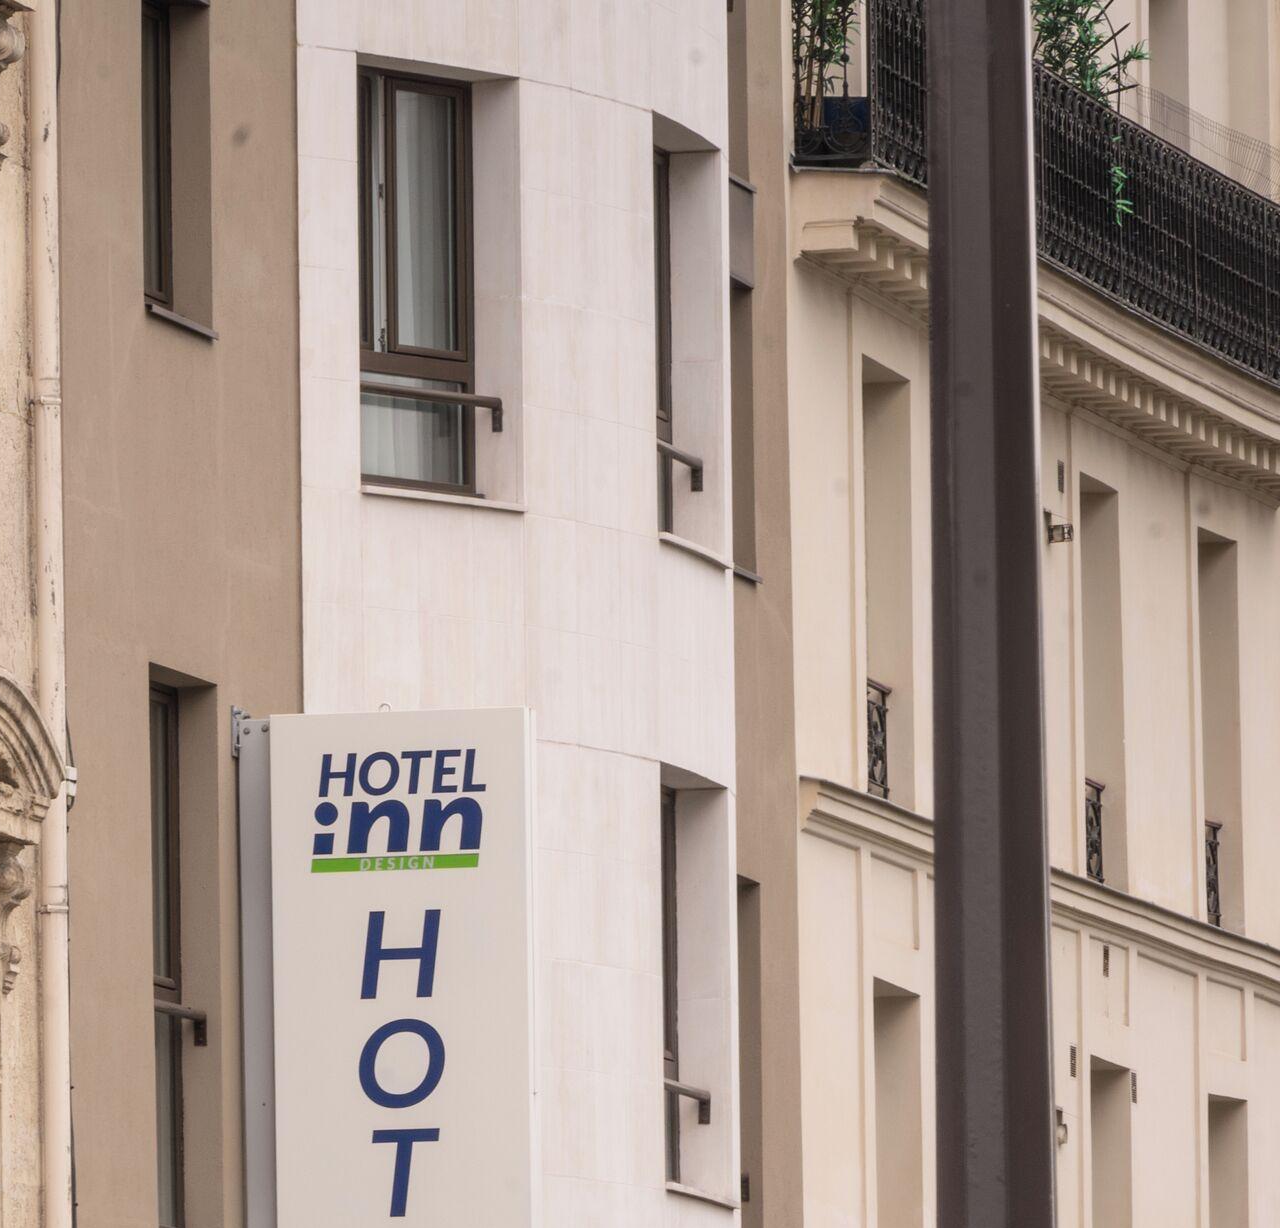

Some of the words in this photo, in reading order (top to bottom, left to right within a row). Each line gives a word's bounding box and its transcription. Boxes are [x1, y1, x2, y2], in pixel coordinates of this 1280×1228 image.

[318, 748, 487, 797] HOTEL
[313, 797, 483, 855] inn
[359, 856, 436, 872] DESIGN
